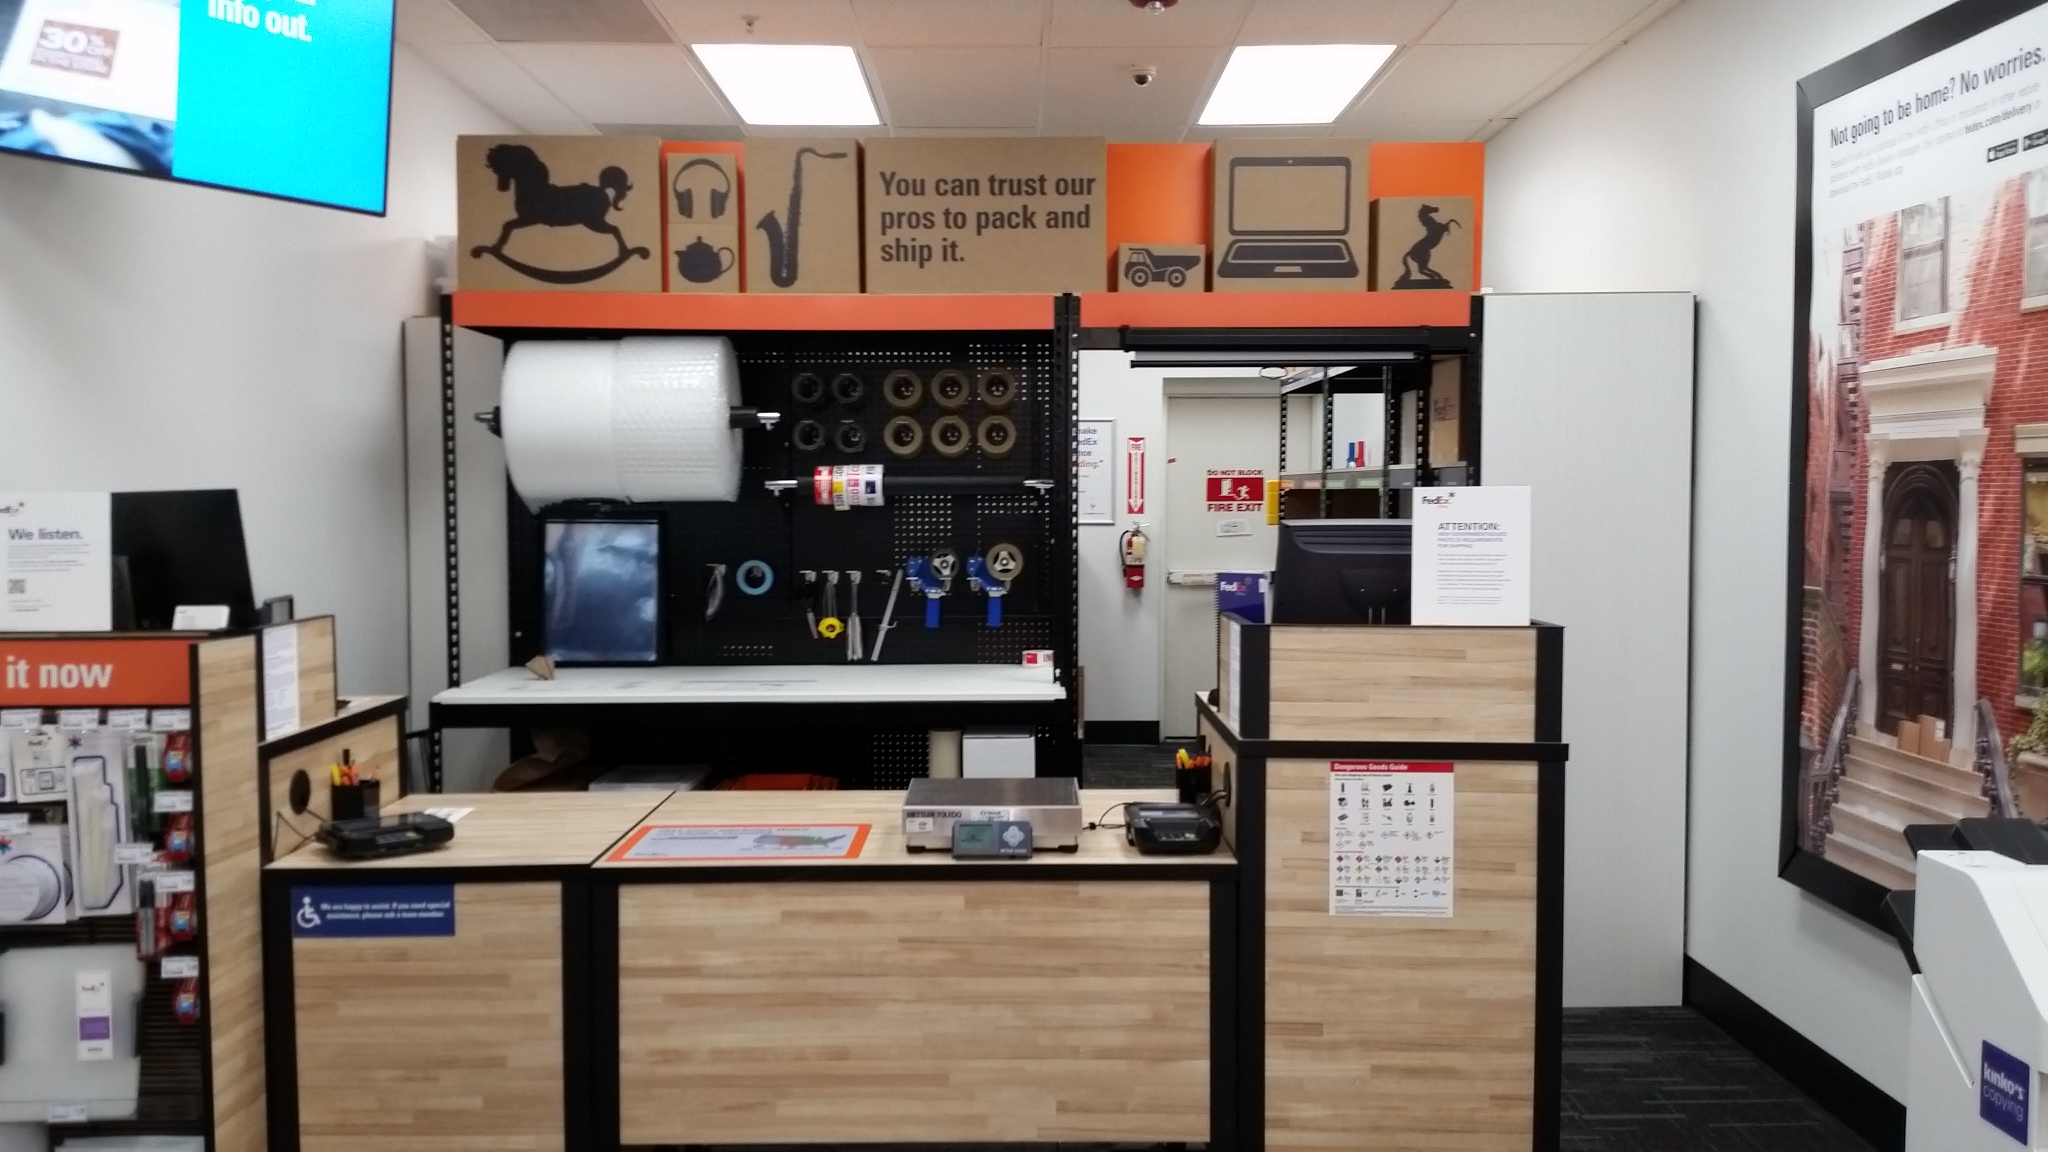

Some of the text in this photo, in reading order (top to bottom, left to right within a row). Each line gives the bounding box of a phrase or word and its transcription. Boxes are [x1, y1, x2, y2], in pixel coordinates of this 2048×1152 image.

[265, 10, 313, 42] out.
[39, 26, 88, 53] 30
[1830, 127, 1849, 149] Not
[1851, 114, 1880, 144] going
[1883, 109, 1894, 126] to
[1897, 99, 1912, 121] be
[1915, 77, 1956, 114] home?
[1960, 70, 1980, 96] No
[1983, 47, 2047, 85] worries.
[879, 171, 1096, 196] You can trust our
[880, 204, 1091, 236] pros to pack and
[880, 237, 966, 269] ship it.
[1207, 503, 1264, 512] FIRE EXIT
[1421, 495, 1450, 505] FedEx
[8, 528, 84, 540] We listen.
[1438, 522, 1501, 531] ATTENTION:
[1220, 581, 1247, 592] FedEx
[6, 655, 113, 689] it now
[1333, 763, 1408, 772] Dangerous Goods Guide
[907, 810, 962, 818] METTLER TOLEDO
[1984, 1062, 2024, 1100] kinko's
[1983, 1085, 2024, 1122] copying
